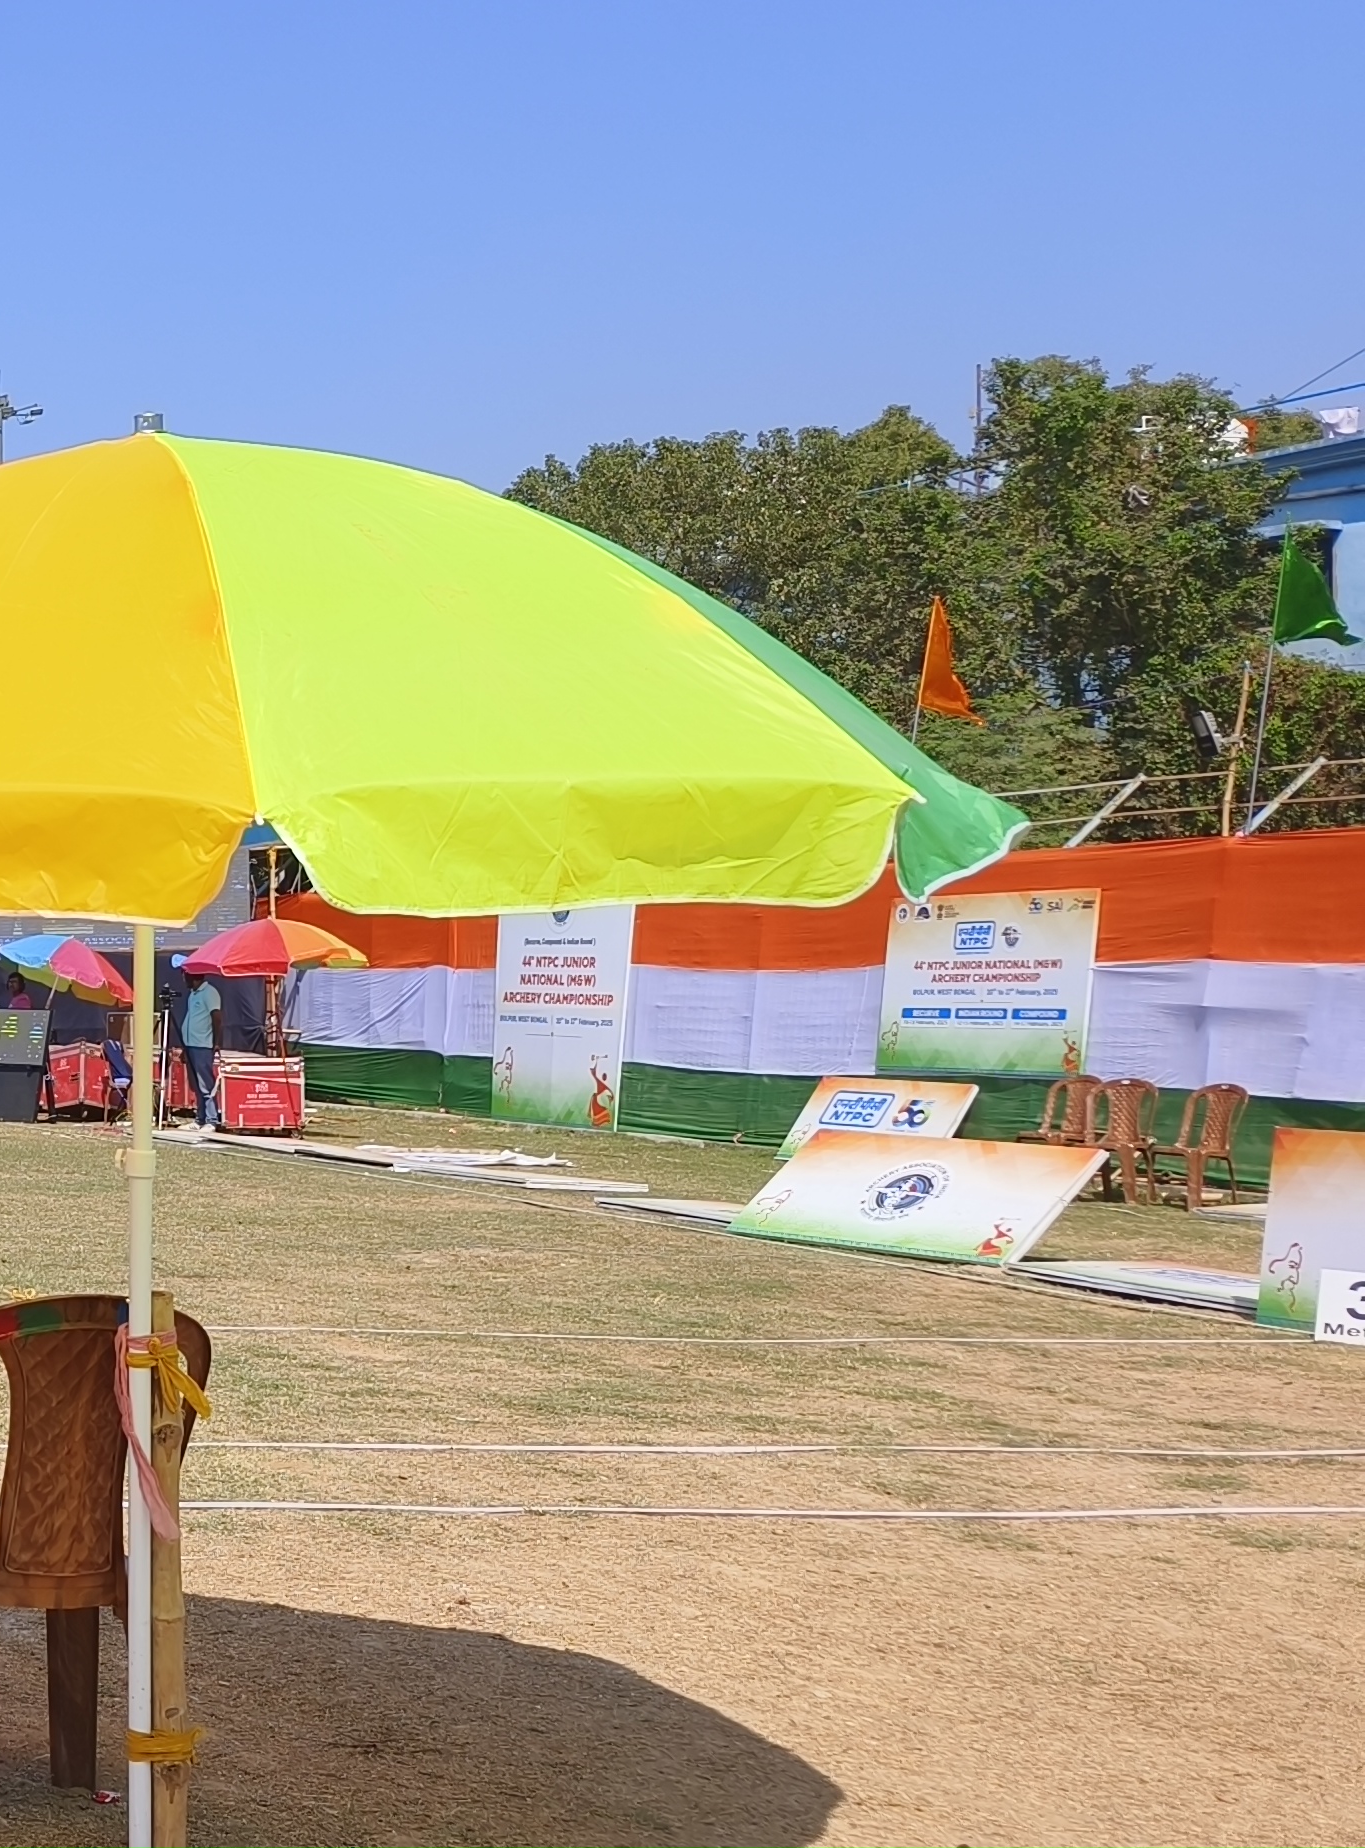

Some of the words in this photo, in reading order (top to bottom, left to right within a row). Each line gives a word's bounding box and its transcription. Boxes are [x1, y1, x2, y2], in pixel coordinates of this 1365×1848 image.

[84, 936, 165, 945] ASSOCIAN
[959, 937, 989, 946] NTPC
[535, 956, 559, 968] NTPC
[560, 956, 596, 969] JUNIOR
[927, 960, 950, 971] NTPC
[950, 960, 984, 971] JUNIOR
[985, 959, 1031, 970] NATIONAL
[1033, 958, 1063, 970] (M&W)
[520, 974, 564, 986] NATIONAL
[567, 974, 596, 987] (M&W)
[931, 973, 971, 984] ARCHERY
[972, 973, 1042, 983] CHAMPIONSHIP
[503, 991, 542, 1004] ARCHERY
[543, 993, 614, 1006] CHAMPIONSHIP
[829, 1110, 874, 1123] NTPC
